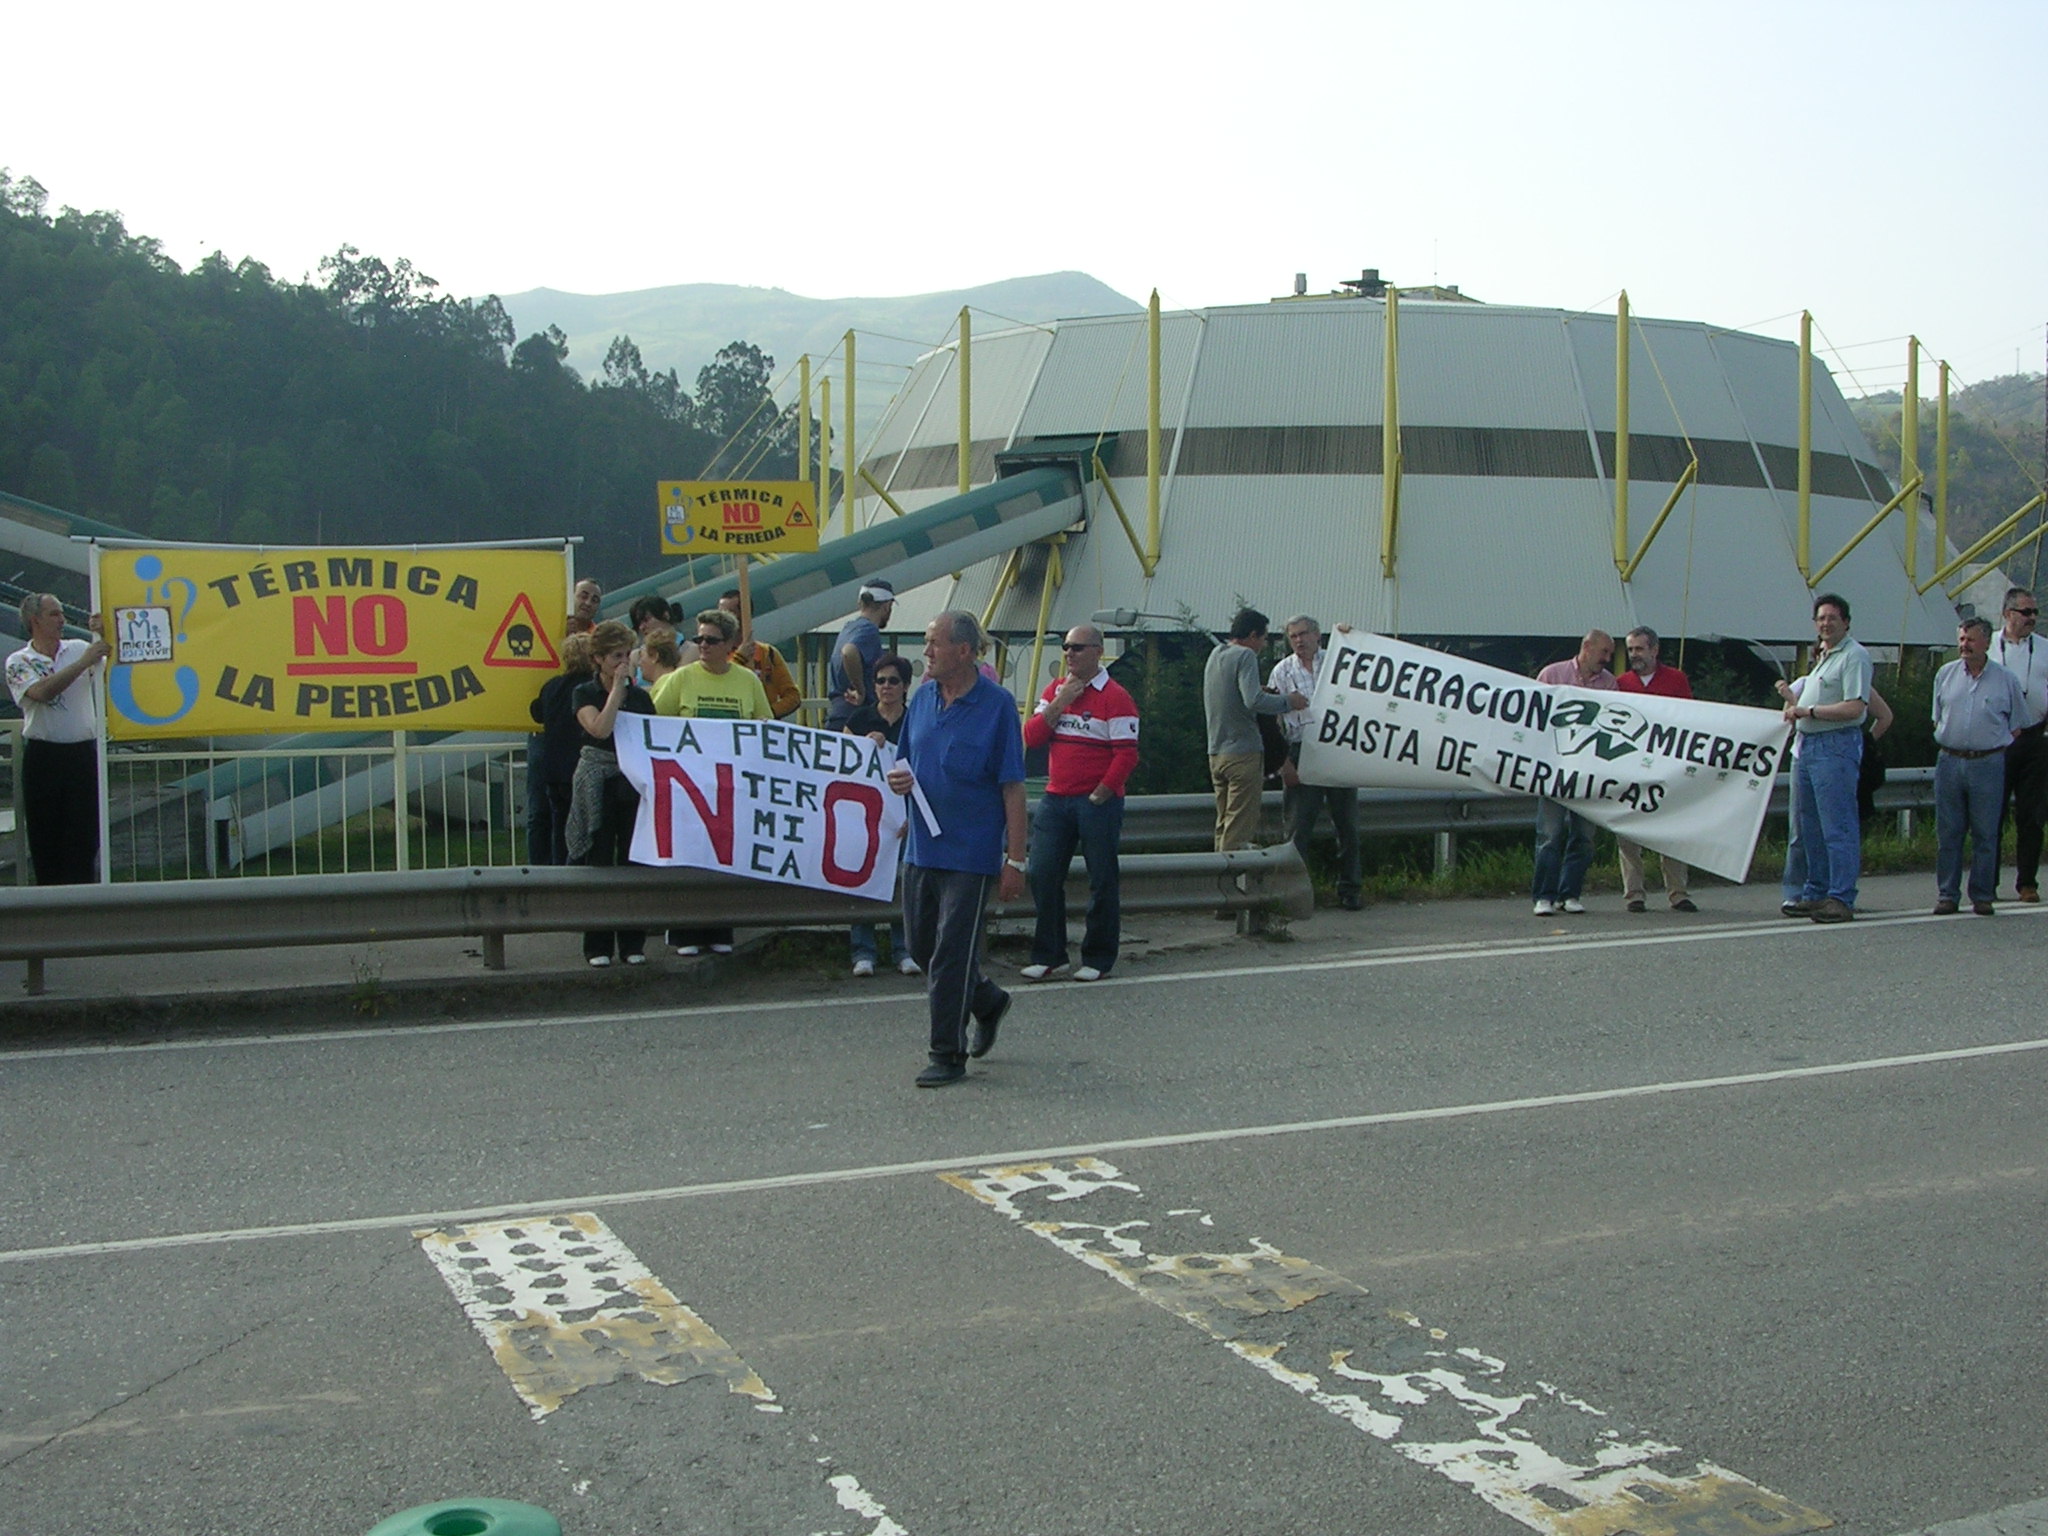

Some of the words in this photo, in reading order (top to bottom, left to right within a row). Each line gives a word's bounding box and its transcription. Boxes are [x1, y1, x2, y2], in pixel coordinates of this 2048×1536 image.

[697, 488, 783, 507] TÉRMICA
[723, 502, 761, 524] NO
[699, 525, 719, 541] LA
[725, 526, 786, 544] PEREDA
[208, 557, 479, 610] TÉRMICA
[293, 594, 409, 656] NO
[215, 664, 276, 712] LA
[295, 665, 486, 719] PEREDA
[1330, 647, 1553, 732] FEDERACION
[642, 719, 702, 754] LA
[732, 723, 885, 782] PEREDA
[1318, 709, 1419, 766] BASTA
[1436, 735, 1478, 777] DE
[1495, 749, 1665, 813] TERMICAS
[1646, 723, 1777, 778] MIERES
[741, 771, 818, 812] TER
[754, 809, 804, 843] MI
[751, 844, 801, 879] CA
